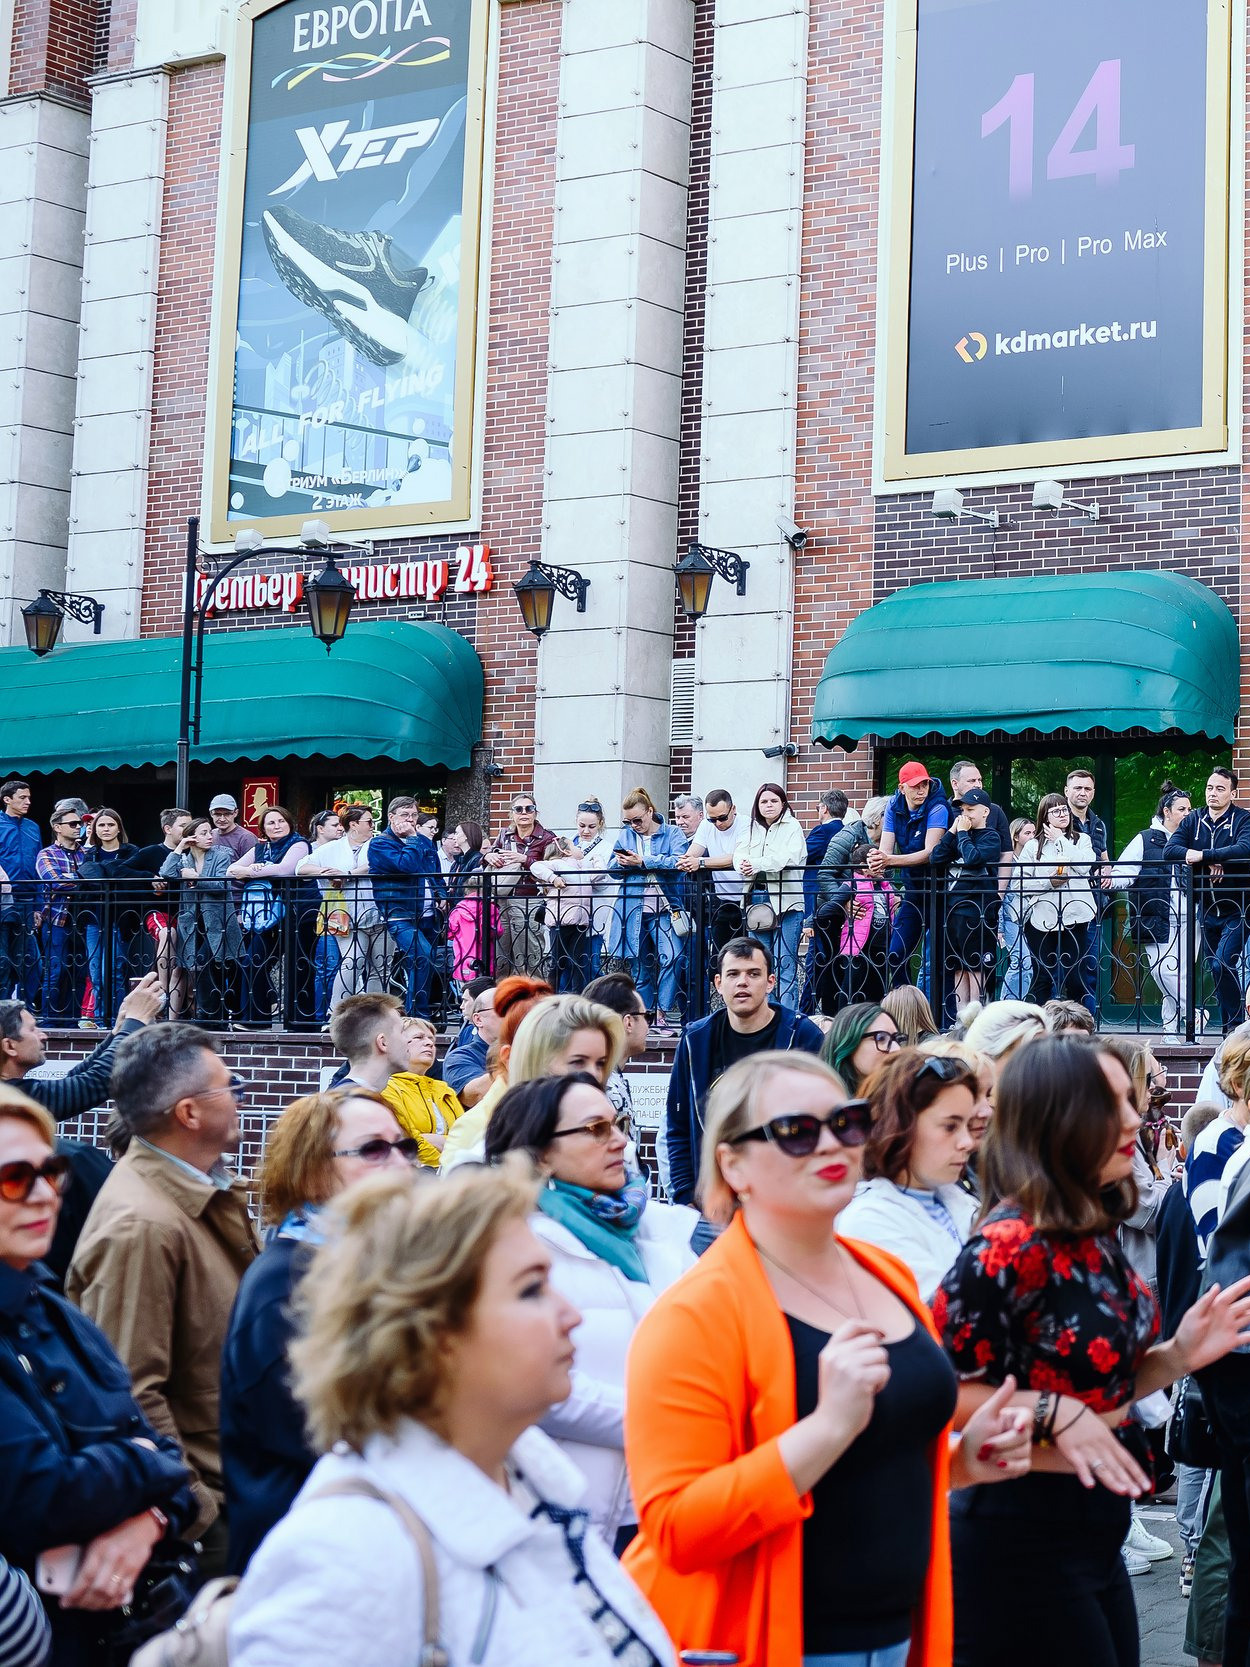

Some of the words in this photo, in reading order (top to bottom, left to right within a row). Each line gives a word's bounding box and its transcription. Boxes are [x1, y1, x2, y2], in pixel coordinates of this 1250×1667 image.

[293, 0, 432, 53] ЕВРОПА
[981, 58, 1135, 199] 14
[946, 252, 988, 274] Plus
[1015, 244, 1050, 266] Pro
[1078, 236, 1113, 257] Pro
[1124, 229, 1168, 251] Max
[995, 319, 1157, 356] kdmarket.ru
[242, 425, 283, 457] ALL
[299, 400, 345, 434] FOR
[357, 364, 445, 414] FLYING
[289, 475, 328, 489] ТРИУМ
[312, 493, 323, 510] 2
[309, 560, 446, 601] нистр
[455, 543, 493, 593] 24
[38, 1070, 68, 1078] СЛУЖЕБН
[629, 1085, 670, 1094] ЛУЖЕБНО
[632, 1097, 668, 1106] НСПОРТ
